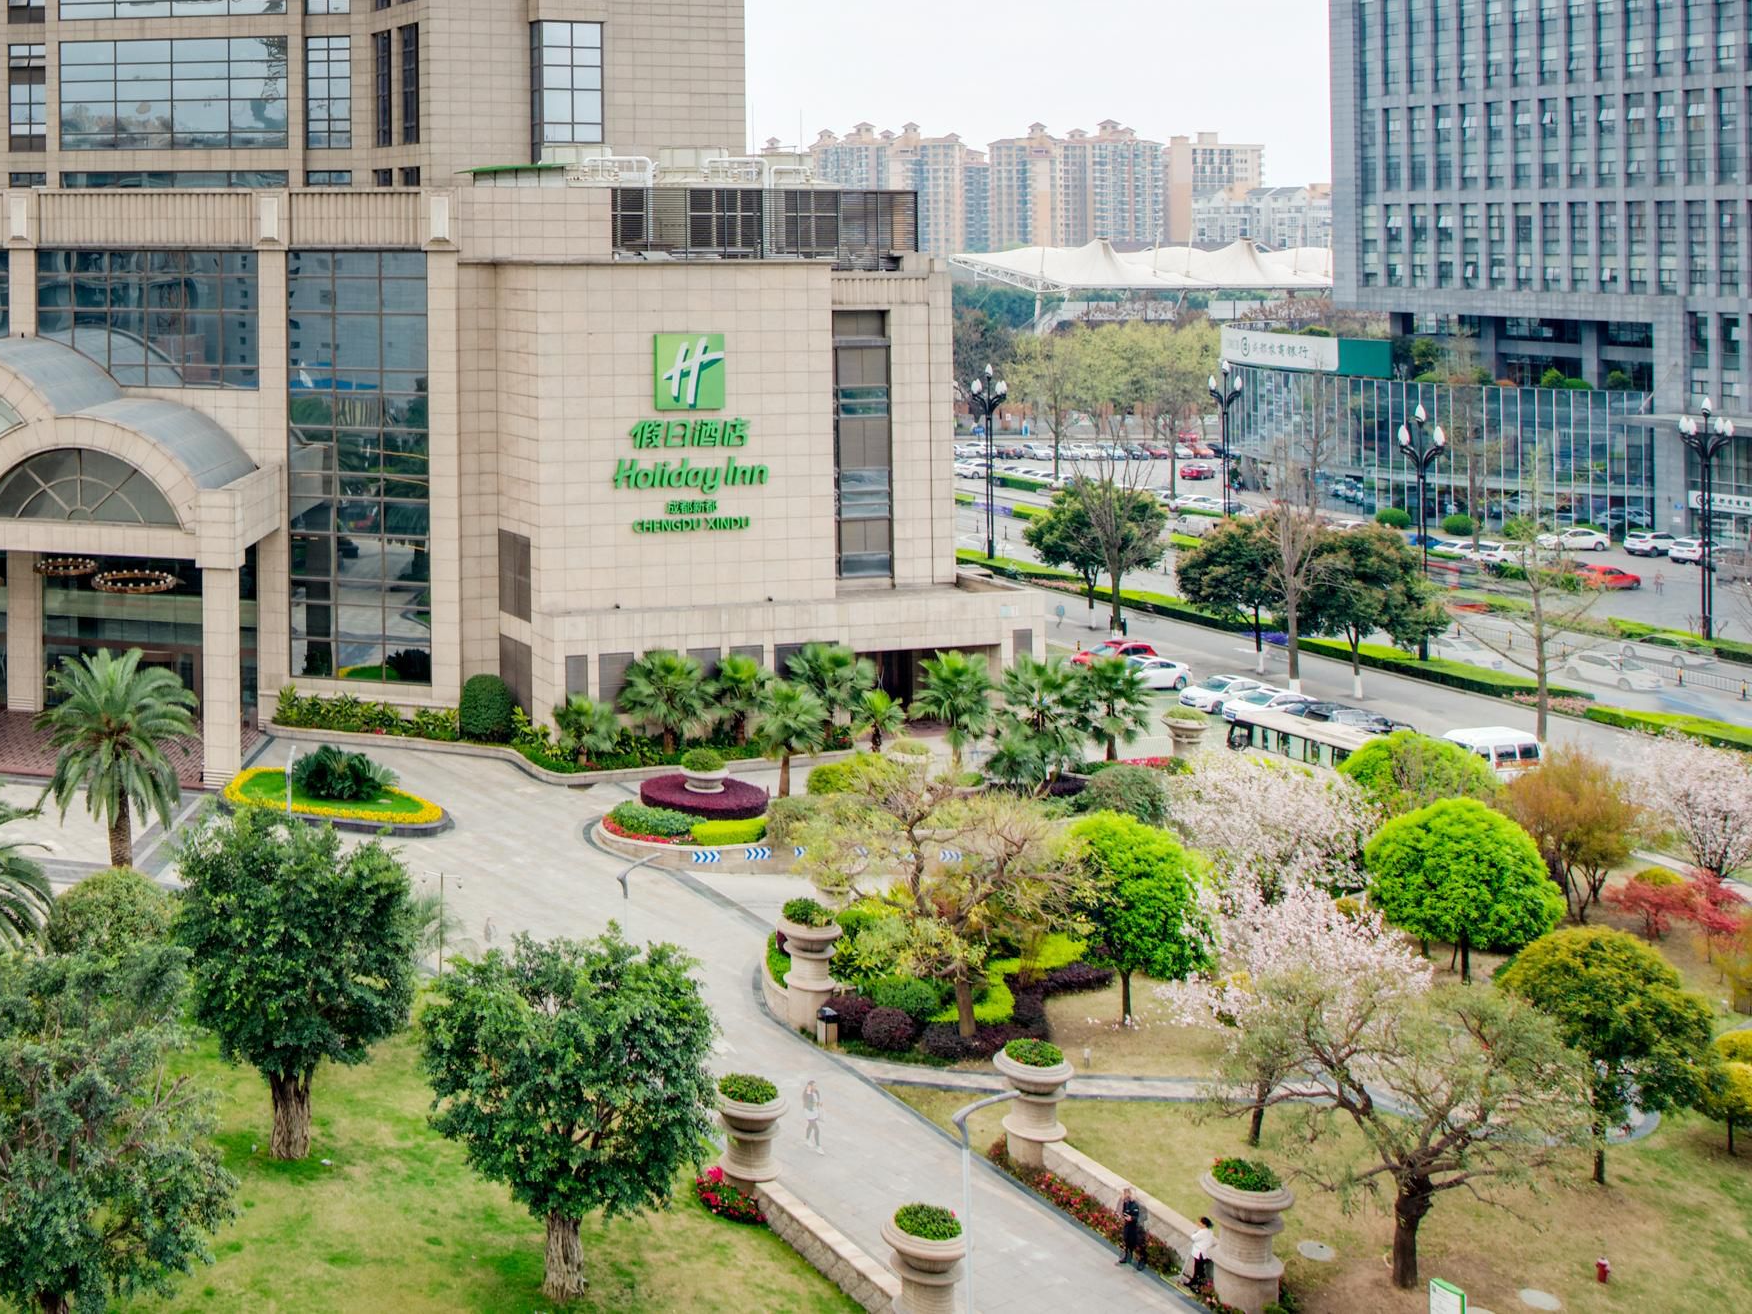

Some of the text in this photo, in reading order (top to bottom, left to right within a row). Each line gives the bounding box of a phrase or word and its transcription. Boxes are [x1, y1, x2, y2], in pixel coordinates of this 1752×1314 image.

[629, 417, 750, 449] 假日酒店
[614, 456, 769, 494] Holiday Inn
[665, 499, 718, 515] 成都新都
[632, 516, 750, 534] CHENGDU XINDU
